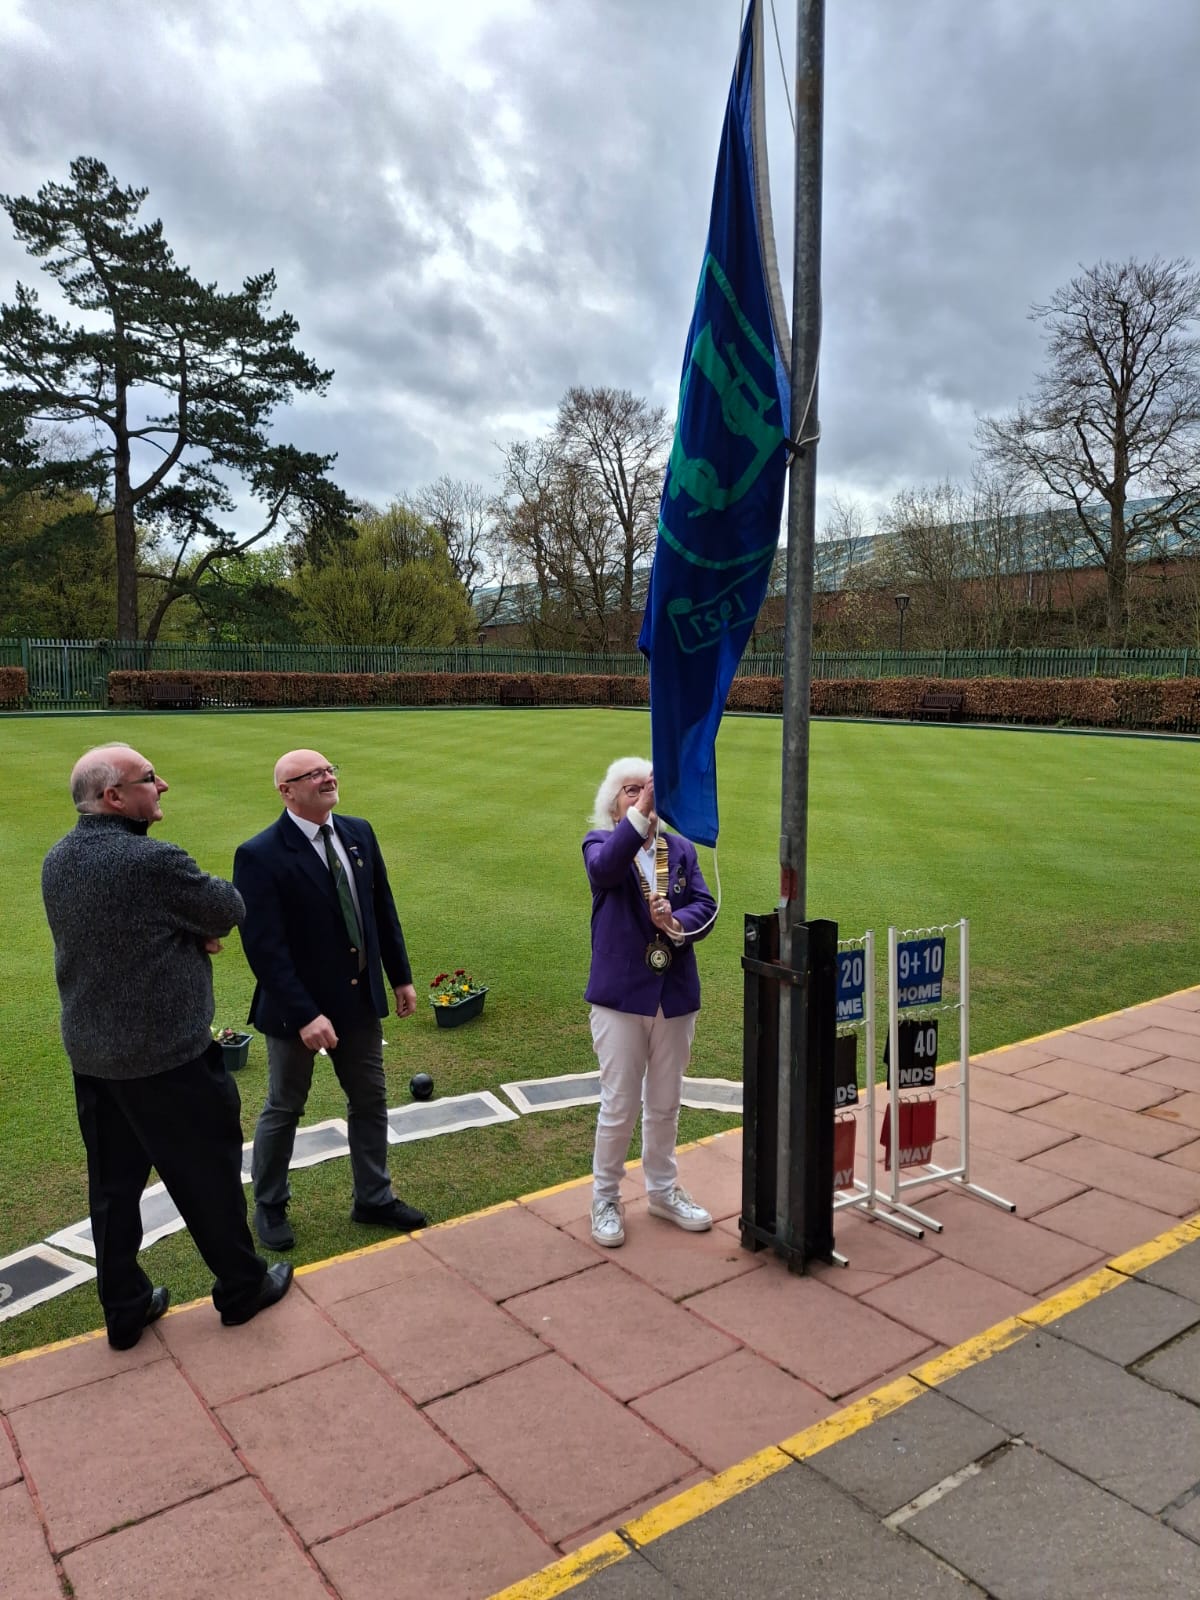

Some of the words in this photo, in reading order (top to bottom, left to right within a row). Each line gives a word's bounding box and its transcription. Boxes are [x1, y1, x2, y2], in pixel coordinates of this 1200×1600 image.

[899, 945, 942, 980] 9+10
[898, 983, 941, 1003] HOME
[836, 998, 862, 1016] ME
[914, 1028, 936, 1058] 40
[899, 1066, 934, 1084] NDS
[835, 1083, 857, 1102] DS
[899, 1146, 931, 1164] WAY
[834, 1168, 853, 1186] AY
